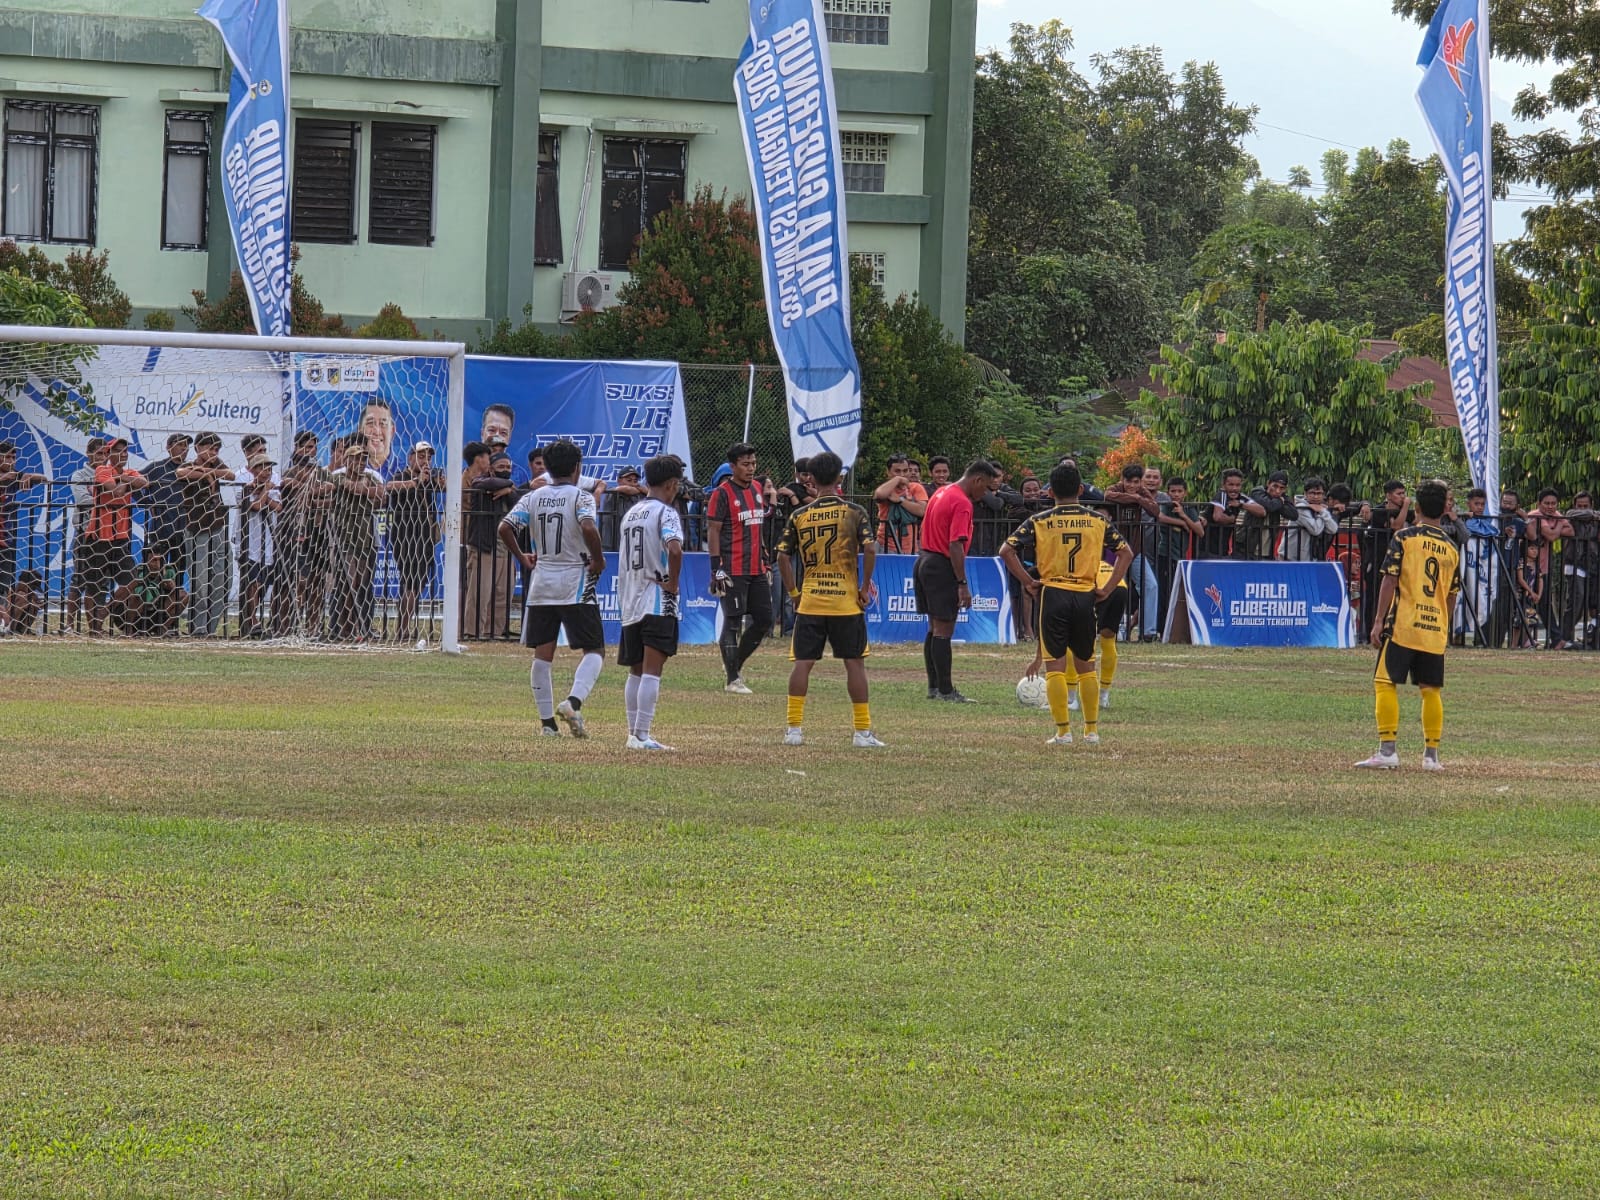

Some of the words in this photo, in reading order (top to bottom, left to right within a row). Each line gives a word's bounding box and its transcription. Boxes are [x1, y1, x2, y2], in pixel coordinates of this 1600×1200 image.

[135, 396, 177, 415] Bank
[197, 400, 261, 424] Sulteng
[538, 512, 563, 555] 17
[623, 526, 644, 571] 13
[800, 523, 838, 568] 27
[1062, 532, 1082, 573] 7
[1245, 583, 1288, 599] PIALA
[1423, 556, 1440, 598] 9
[1230, 600, 1307, 616] GUBERNUR
